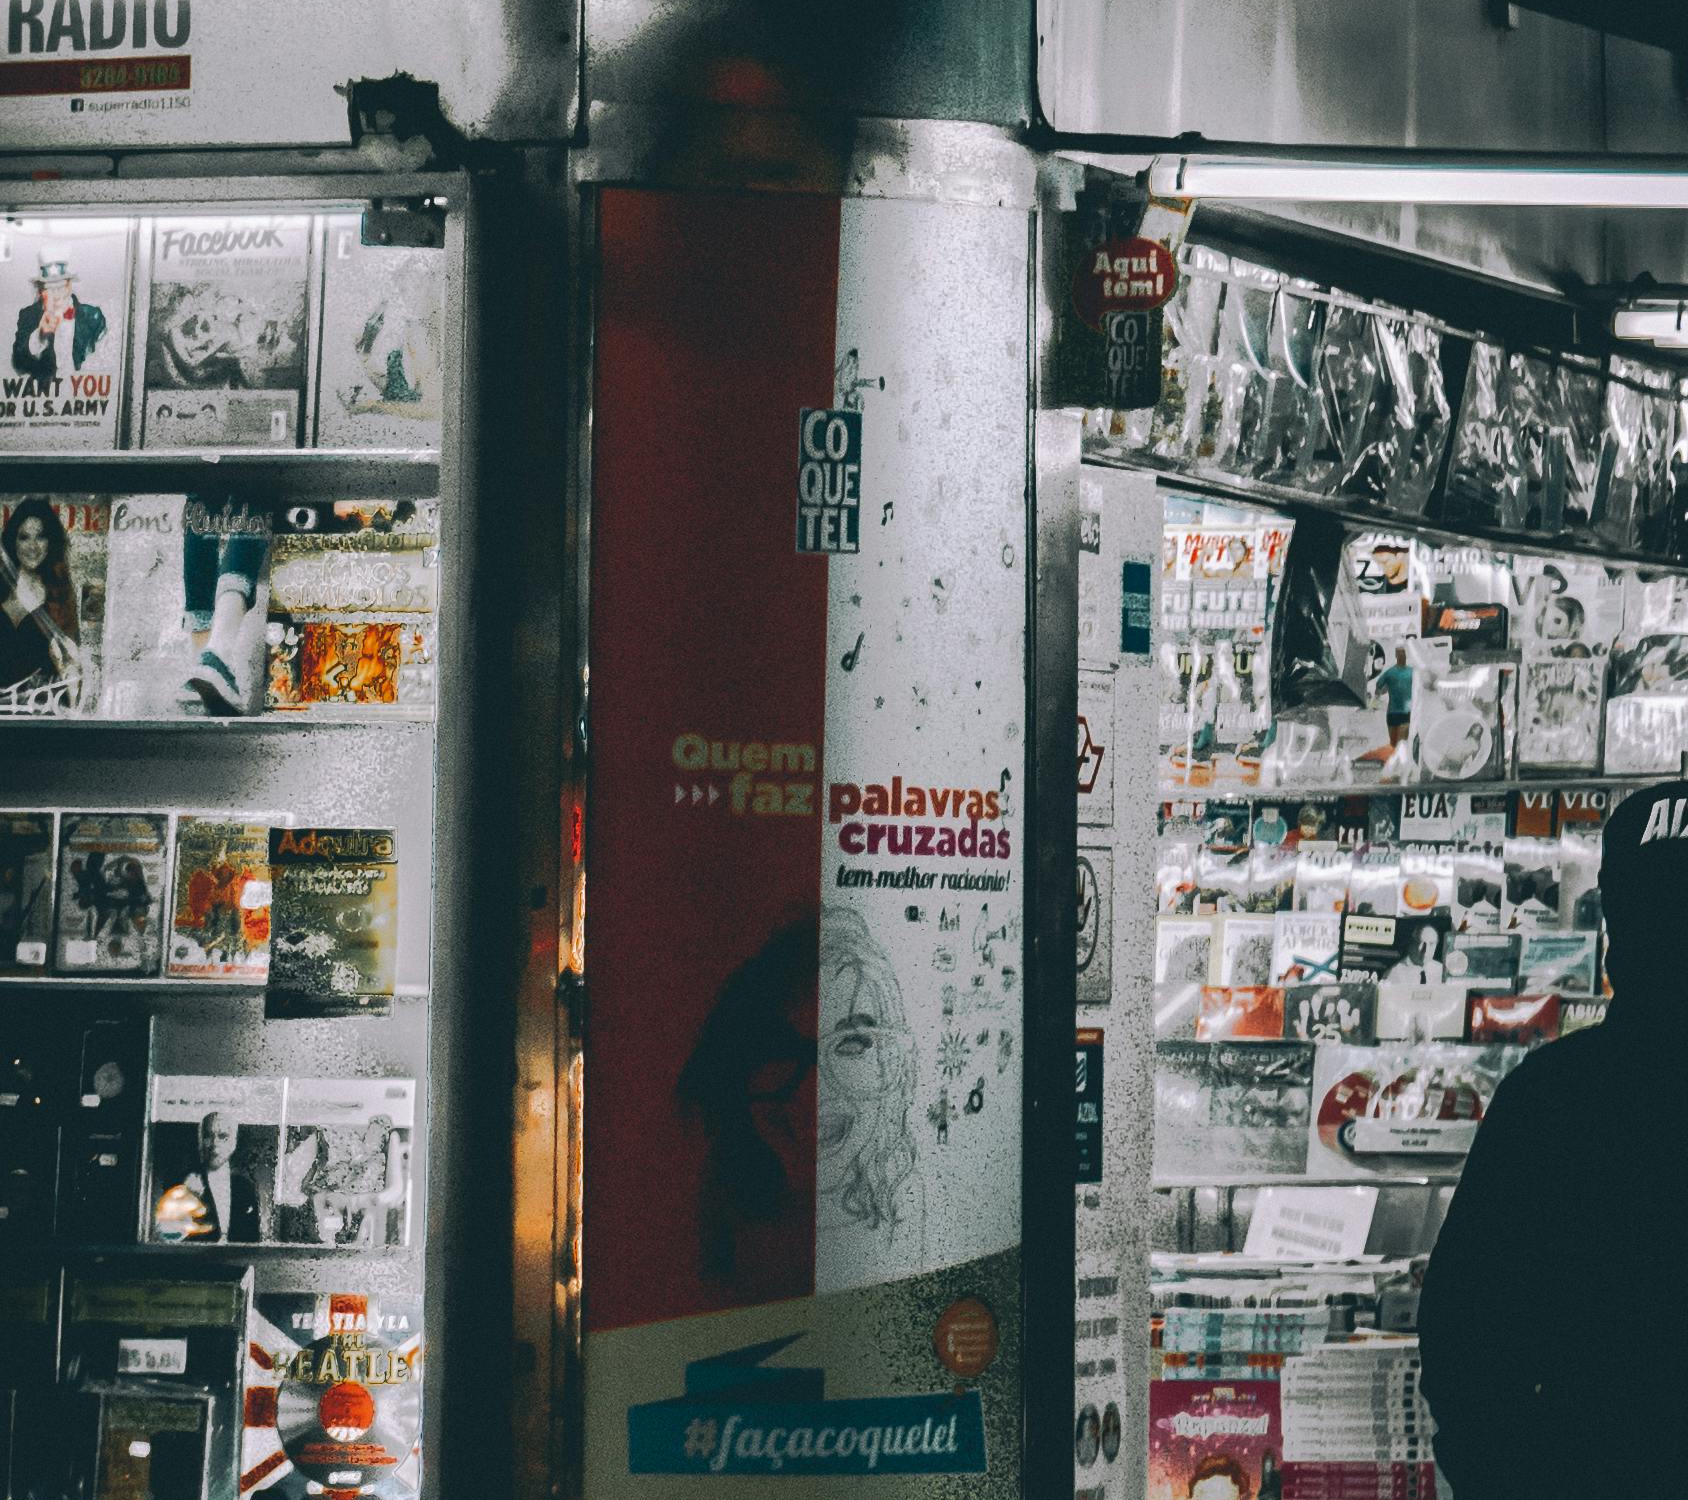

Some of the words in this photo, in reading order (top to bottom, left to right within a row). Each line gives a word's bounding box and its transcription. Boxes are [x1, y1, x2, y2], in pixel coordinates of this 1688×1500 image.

[162, 222, 285, 261] Facebook
[1093, 249, 1158, 279] Aqui
[1103, 273, 1165, 297] tem!
[1110, 314, 1138, 344] CO
[3, 375, 63, 399] WANT
[70, 375, 111, 397] YOU
[803, 409, 850, 461] CO
[800, 463, 859, 507] QUE
[801, 508, 858, 553] TEL
[672, 734, 816, 773] Quem
[730, 772, 814, 816] faz
[829, 776, 999, 823] palavras
[1403, 792, 1449, 819] EUA
[838, 815, 1011, 859] cruzadas
[684, 1414, 957, 1472] #façacoquetel
